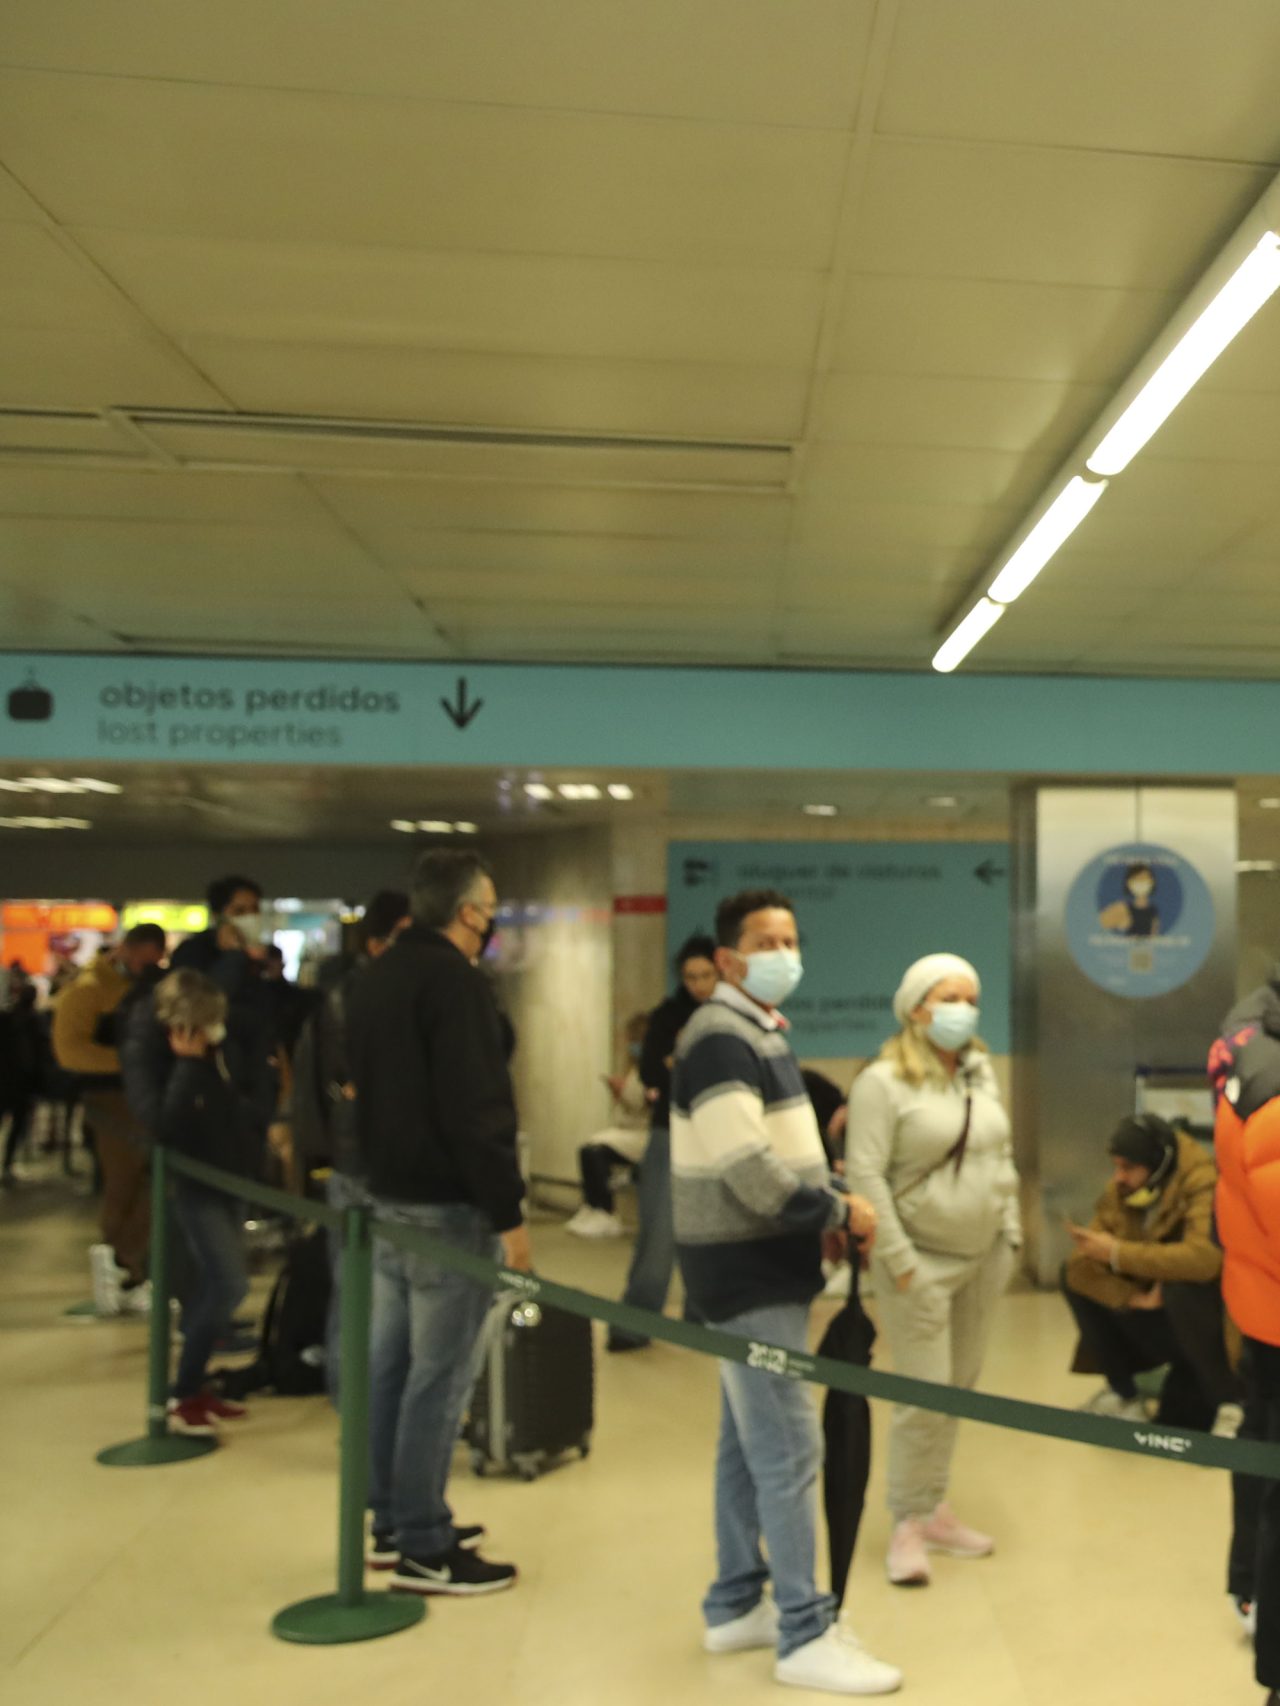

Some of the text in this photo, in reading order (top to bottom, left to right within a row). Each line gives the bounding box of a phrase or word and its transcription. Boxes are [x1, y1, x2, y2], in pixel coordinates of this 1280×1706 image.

[99, 682, 400, 716] objetos perdidos
[98, 720, 343, 750] lost properties
